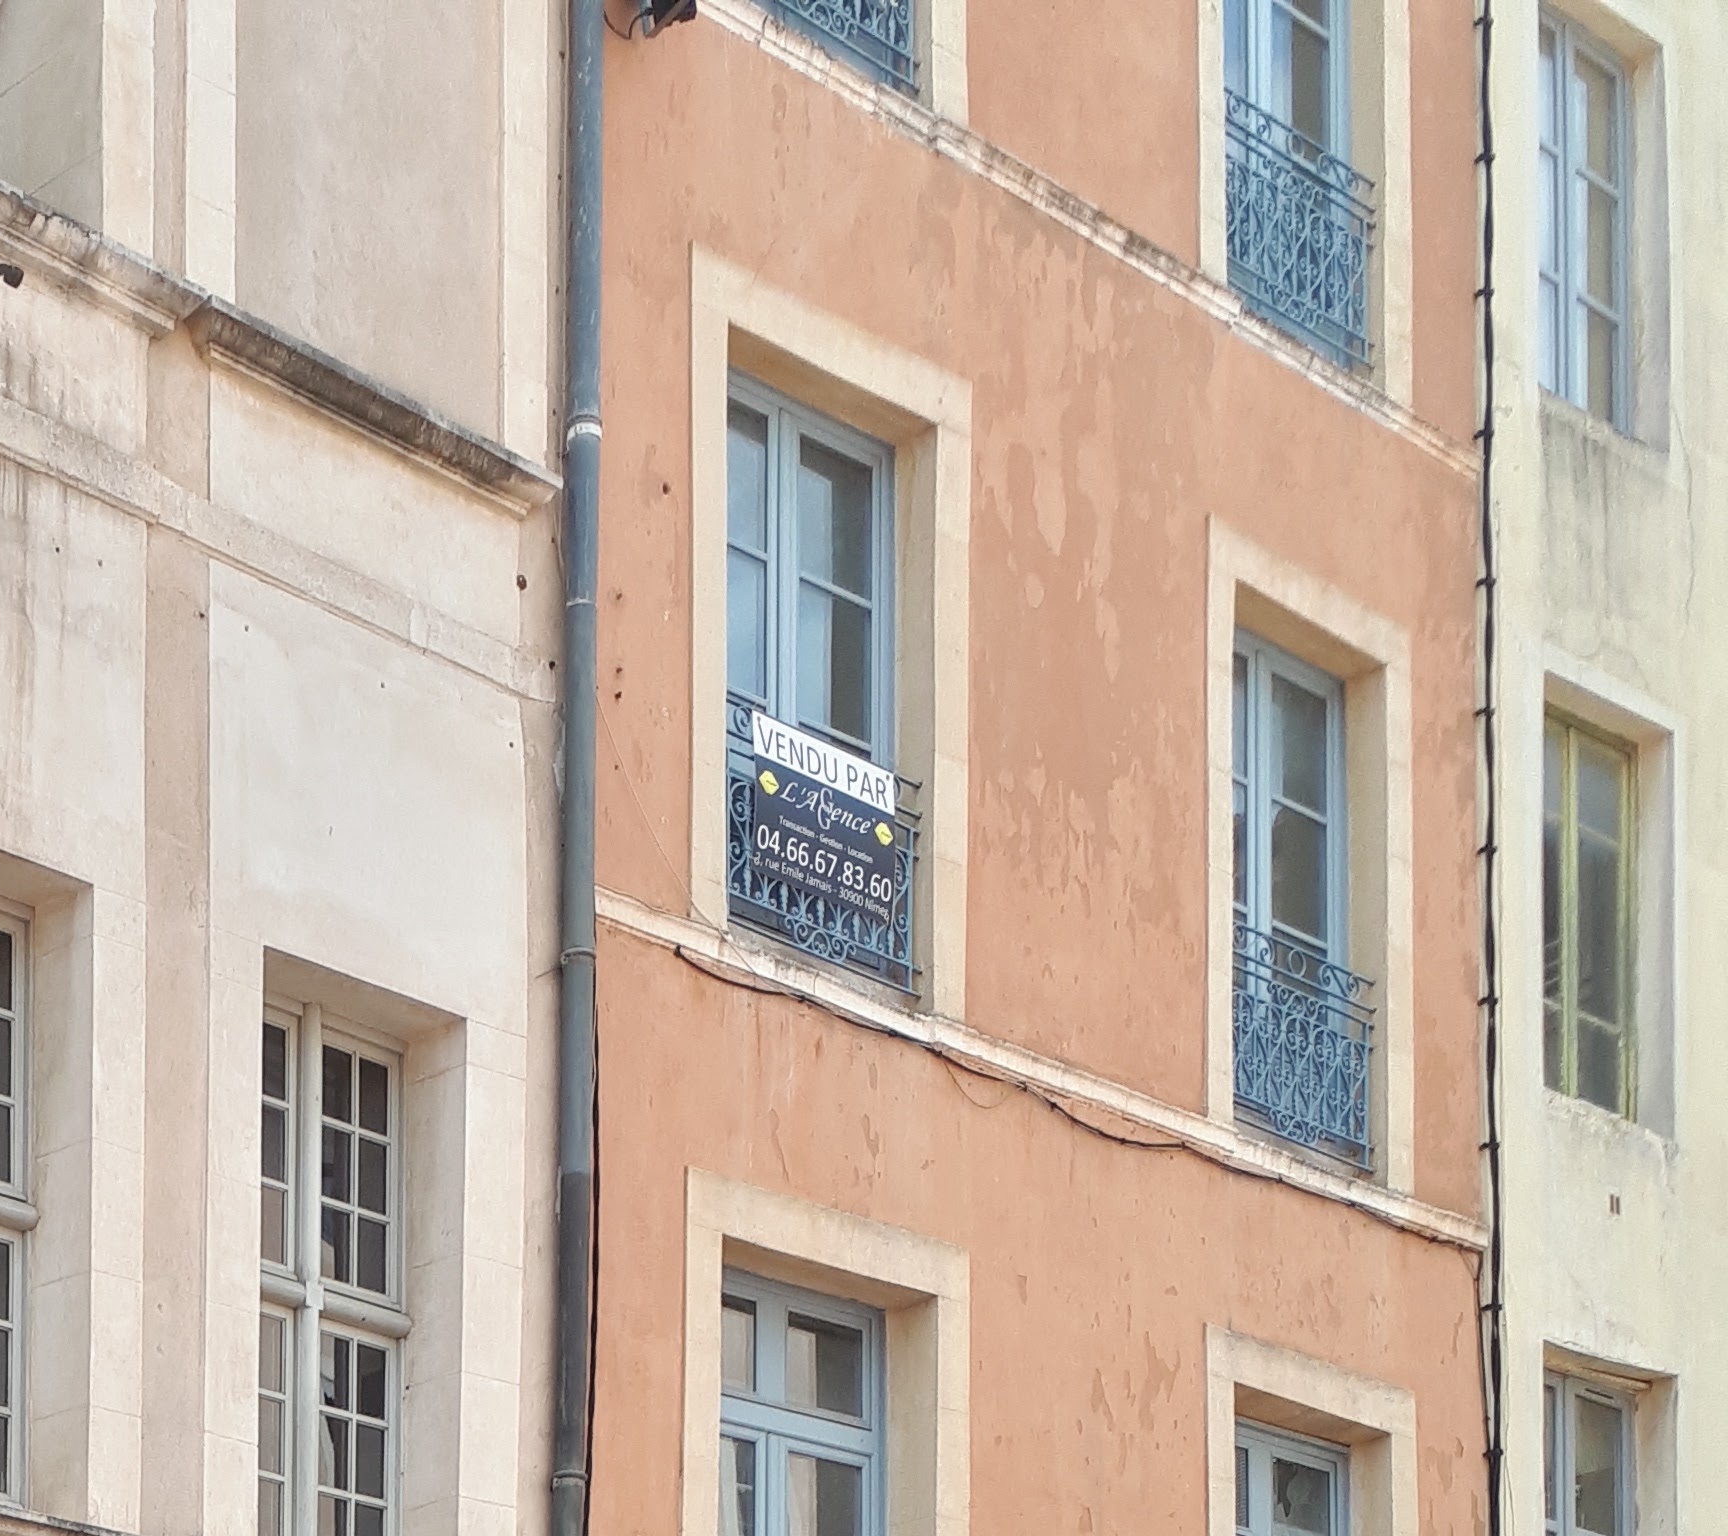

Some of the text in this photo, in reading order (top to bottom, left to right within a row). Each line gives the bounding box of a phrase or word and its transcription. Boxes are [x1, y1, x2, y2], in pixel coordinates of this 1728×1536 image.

[758, 723, 888, 809] VENDU PAR
[757, 825, 892, 902] 04.66.67.83.60
[779, 815, 815, 839] Transaction
[847, 846, 874, 864] Location
[765, 857, 779, 871] rue
[781, 861, 804, 882] Emile
[806, 873, 832, 894] Jamais
[838, 886, 864, 906] 30900
